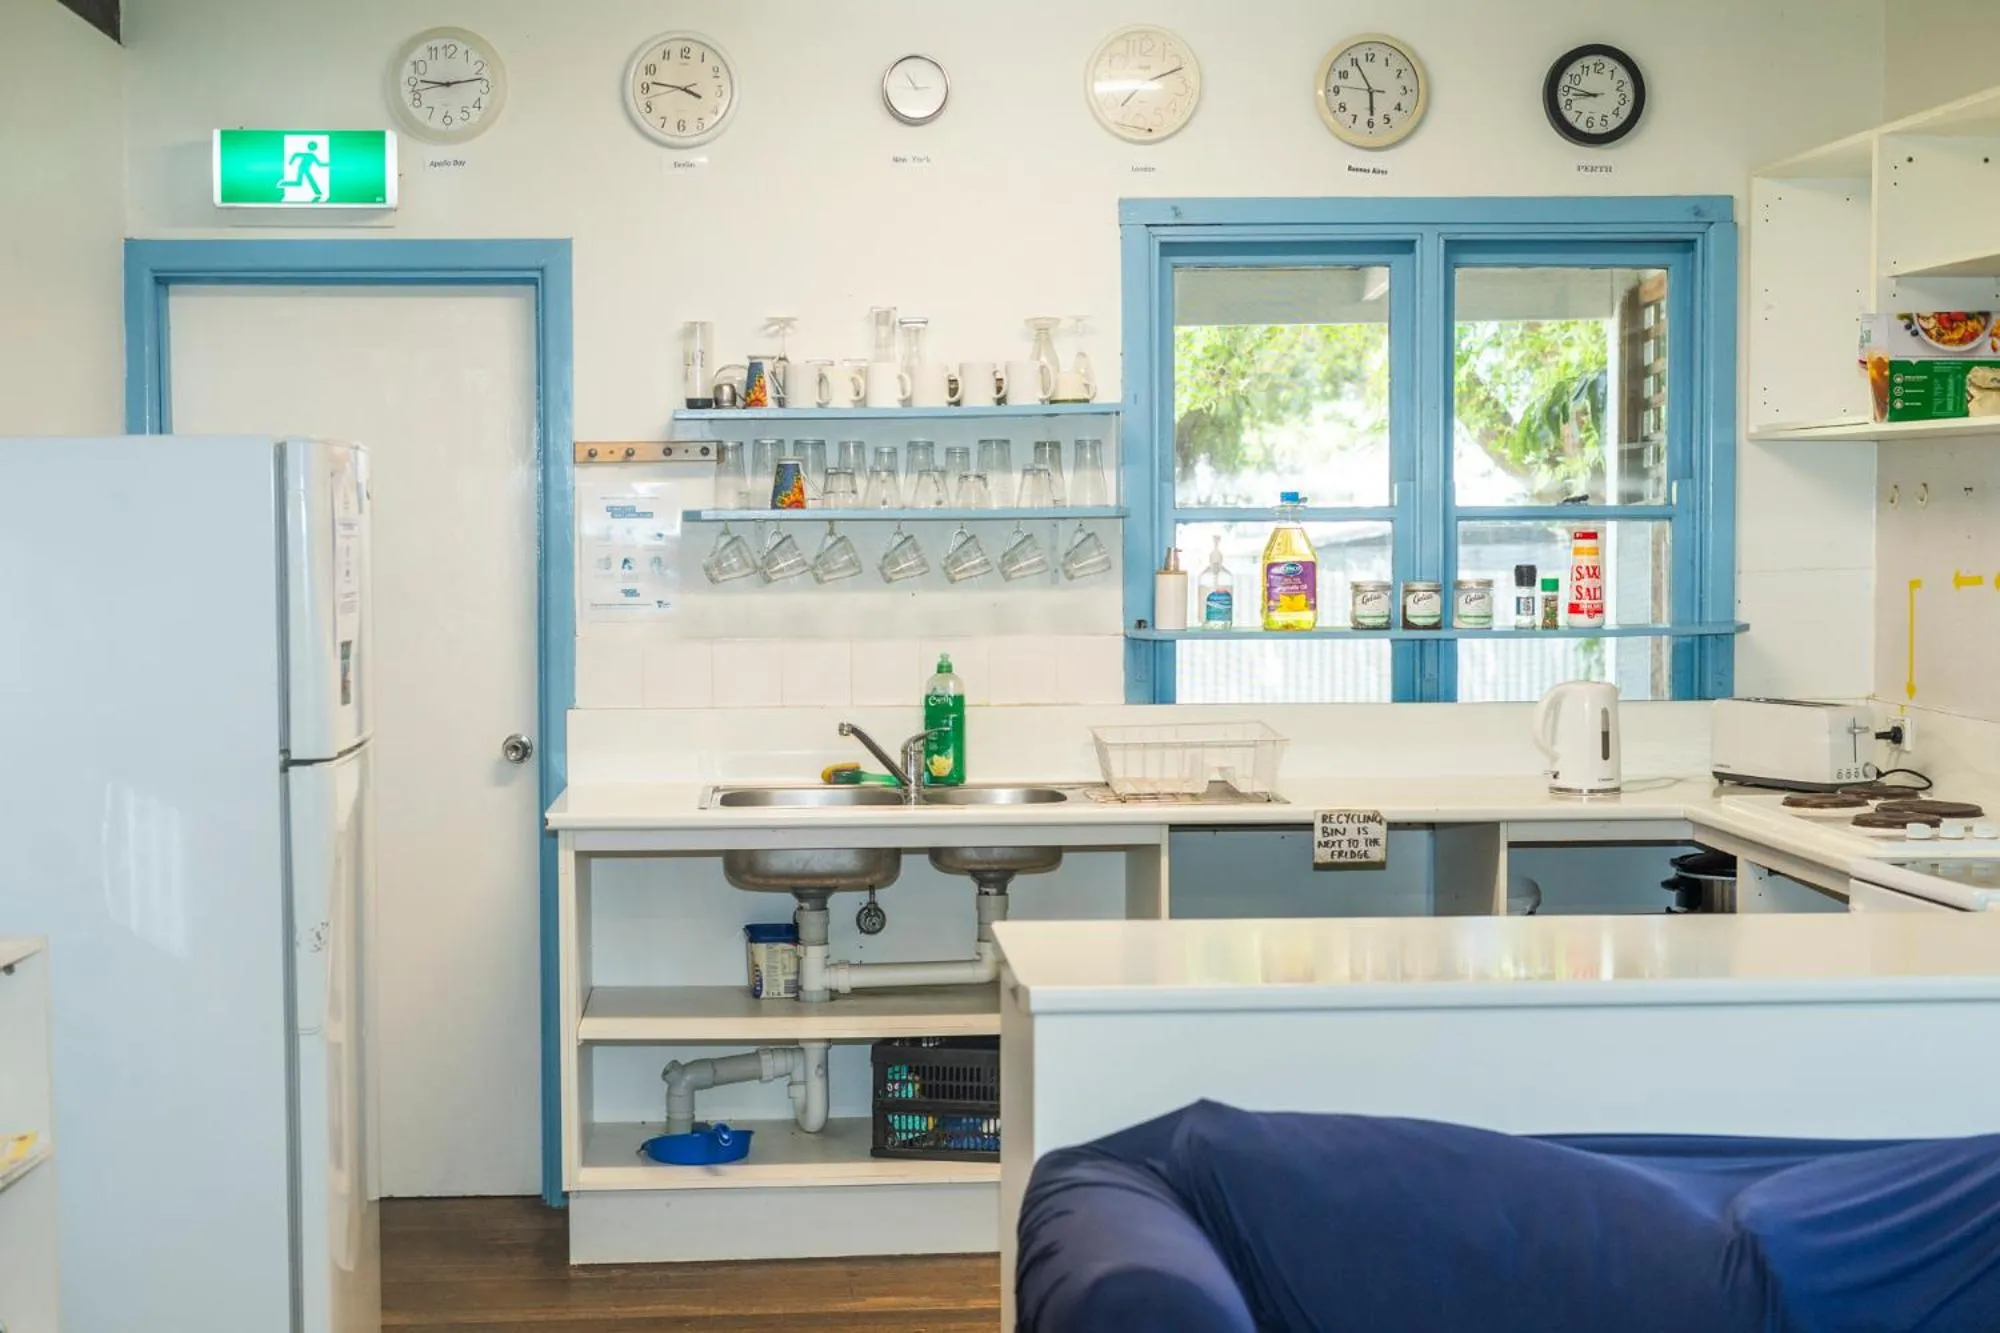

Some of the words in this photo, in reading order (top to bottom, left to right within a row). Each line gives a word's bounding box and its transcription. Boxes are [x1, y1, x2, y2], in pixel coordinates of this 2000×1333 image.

[428, 46, 438, 60] 11
[442, 44, 458, 60] 12
[464, 49, 469, 63] 1
[662, 49, 671, 61] 11
[680, 46, 691, 60] 12
[701, 52, 705, 63] 1
[1365, 53, 1376, 63] 12
[411, 60, 427, 76] 10
[474, 60, 485, 75] 2
[1351, 58, 1359, 67] 11
[1385, 57, 1389, 67] 1
[1593, 61, 1605, 75] 12
[645, 64, 657, 76] 10
[1338, 70, 1349, 80] 10
[1396, 69, 1402, 79] 2
[1581, 64, 1590, 76] 11
[1610, 69, 1614, 80] 1
[1569, 74, 1582, 86] 10
[480, 79, 490, 96] 3
[641, 82, 650, 95] 9
[1333, 86, 1340, 96] 9
[1400, 86, 1408, 97] 3
[1562, 85, 1570, 97] 9
[1616, 80, 1625, 93] 2
[413, 91, 422, 108] 8
[472, 97, 482, 111] 4
[1564, 99, 1573, 111] 8
[1619, 93, 1627, 106] 3
[426, 106, 435, 120] 7
[644, 100, 653, 114] 8
[1338, 102, 1347, 113] 8
[1394, 102, 1402, 112] 4
[1612, 107, 1620, 118] 4
[442, 111, 453, 126] 6
[460, 106, 470, 121] 5
[1351, 114, 1358, 124] 7
[1383, 114, 1391, 125] 5
[1575, 110, 1583, 123] 7
[660, 117, 667, 129] 7
[677, 119, 686, 133] 6
[696, 118, 704, 131] 5
[1367, 118, 1375, 129] 6
[1586, 116, 1595, 129] 6
[1600, 114, 1609, 127] 5
[1321, 813, 1383, 826] RECYCLING
[1322, 826, 1346, 837] BIN
[1357, 825, 1369, 835] IS
[1317, 839, 1344, 848] NEXT
[1345, 839, 1359, 848] TO
[1364, 838, 1381, 847] THE
[1331, 850, 1371, 859] FRIDGE
